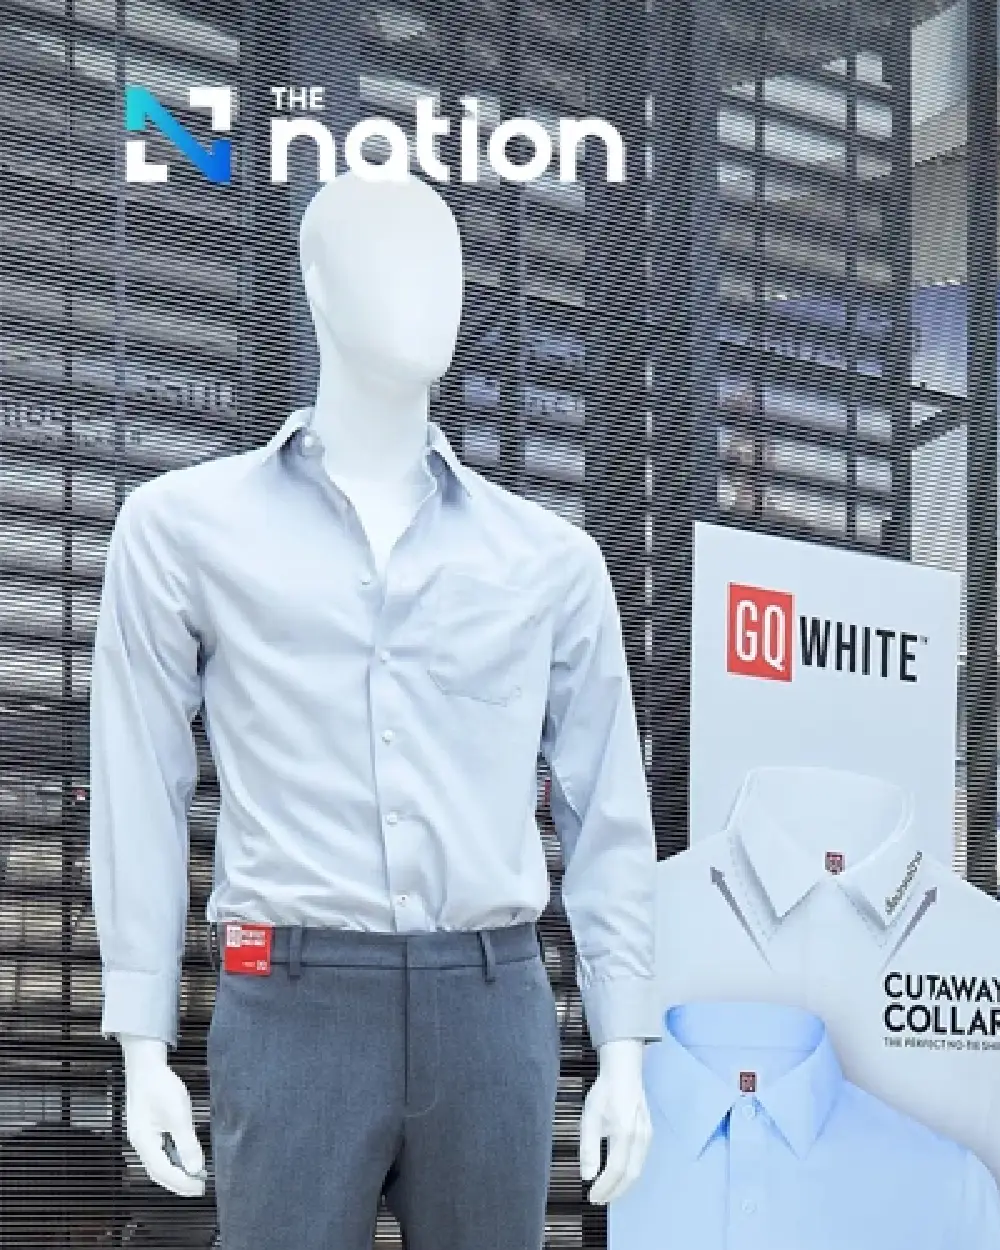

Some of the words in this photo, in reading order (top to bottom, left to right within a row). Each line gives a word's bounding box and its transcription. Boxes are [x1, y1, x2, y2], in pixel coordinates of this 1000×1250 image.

[735, 599, 786, 673] GQ
[884, 1036, 903, 1048] THE
[904, 1036, 946, 1051] PERFECT
